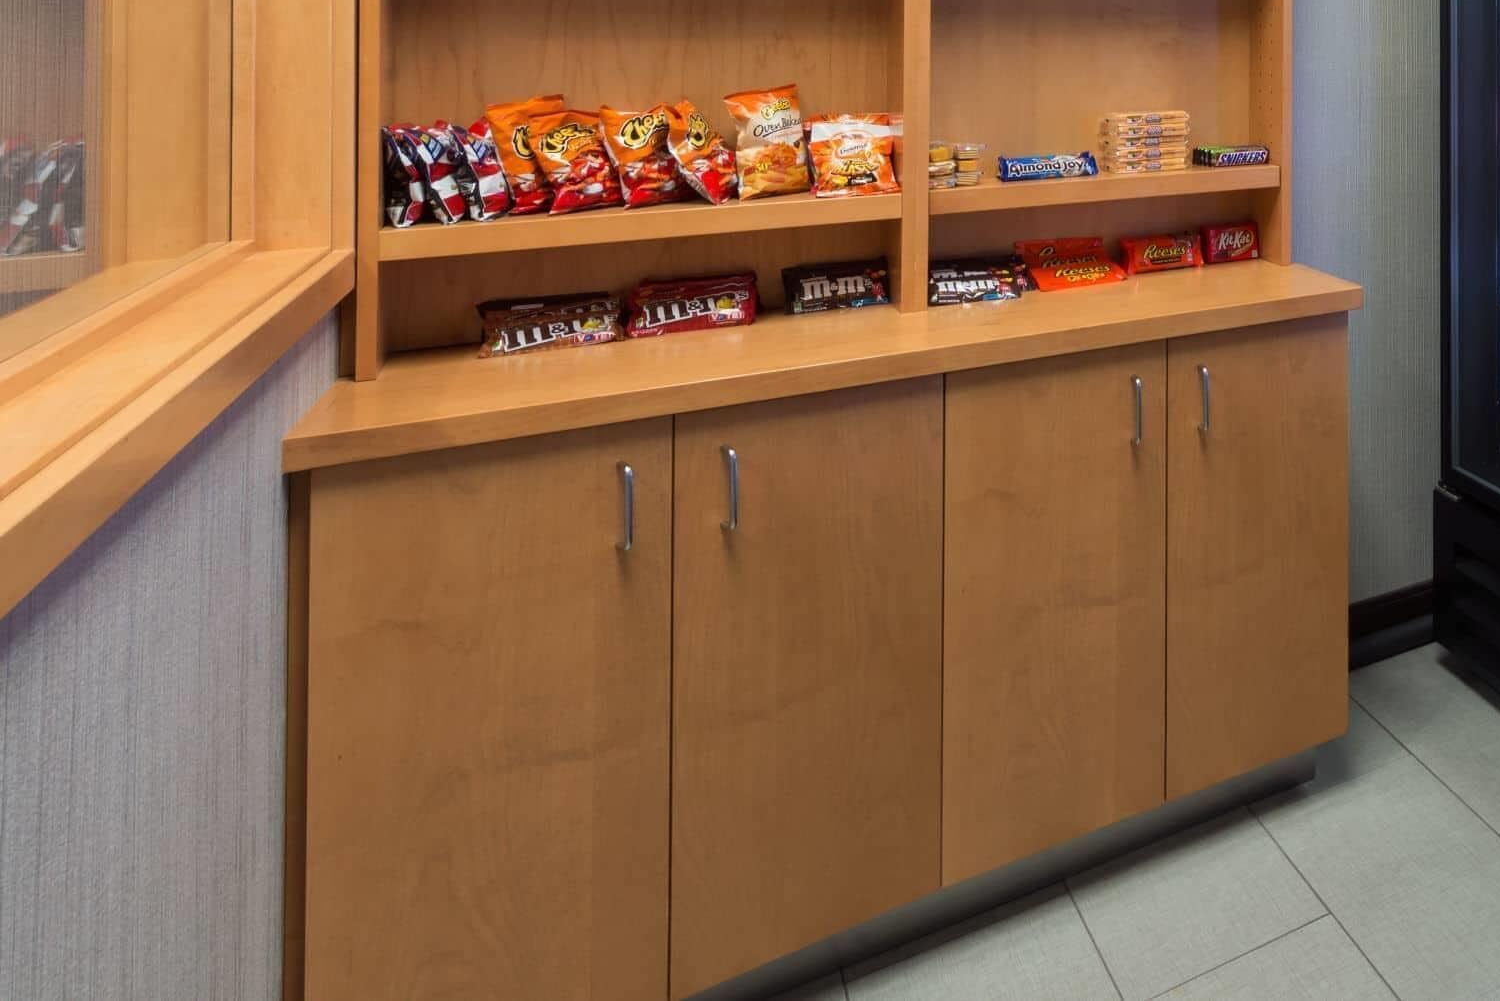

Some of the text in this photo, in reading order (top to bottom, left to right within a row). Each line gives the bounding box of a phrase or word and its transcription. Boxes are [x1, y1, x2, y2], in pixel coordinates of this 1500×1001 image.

[753, 121, 782, 137] Oven
[1218, 151, 1267, 166] SNICKERS
[1008, 162, 1061, 178] Almond
